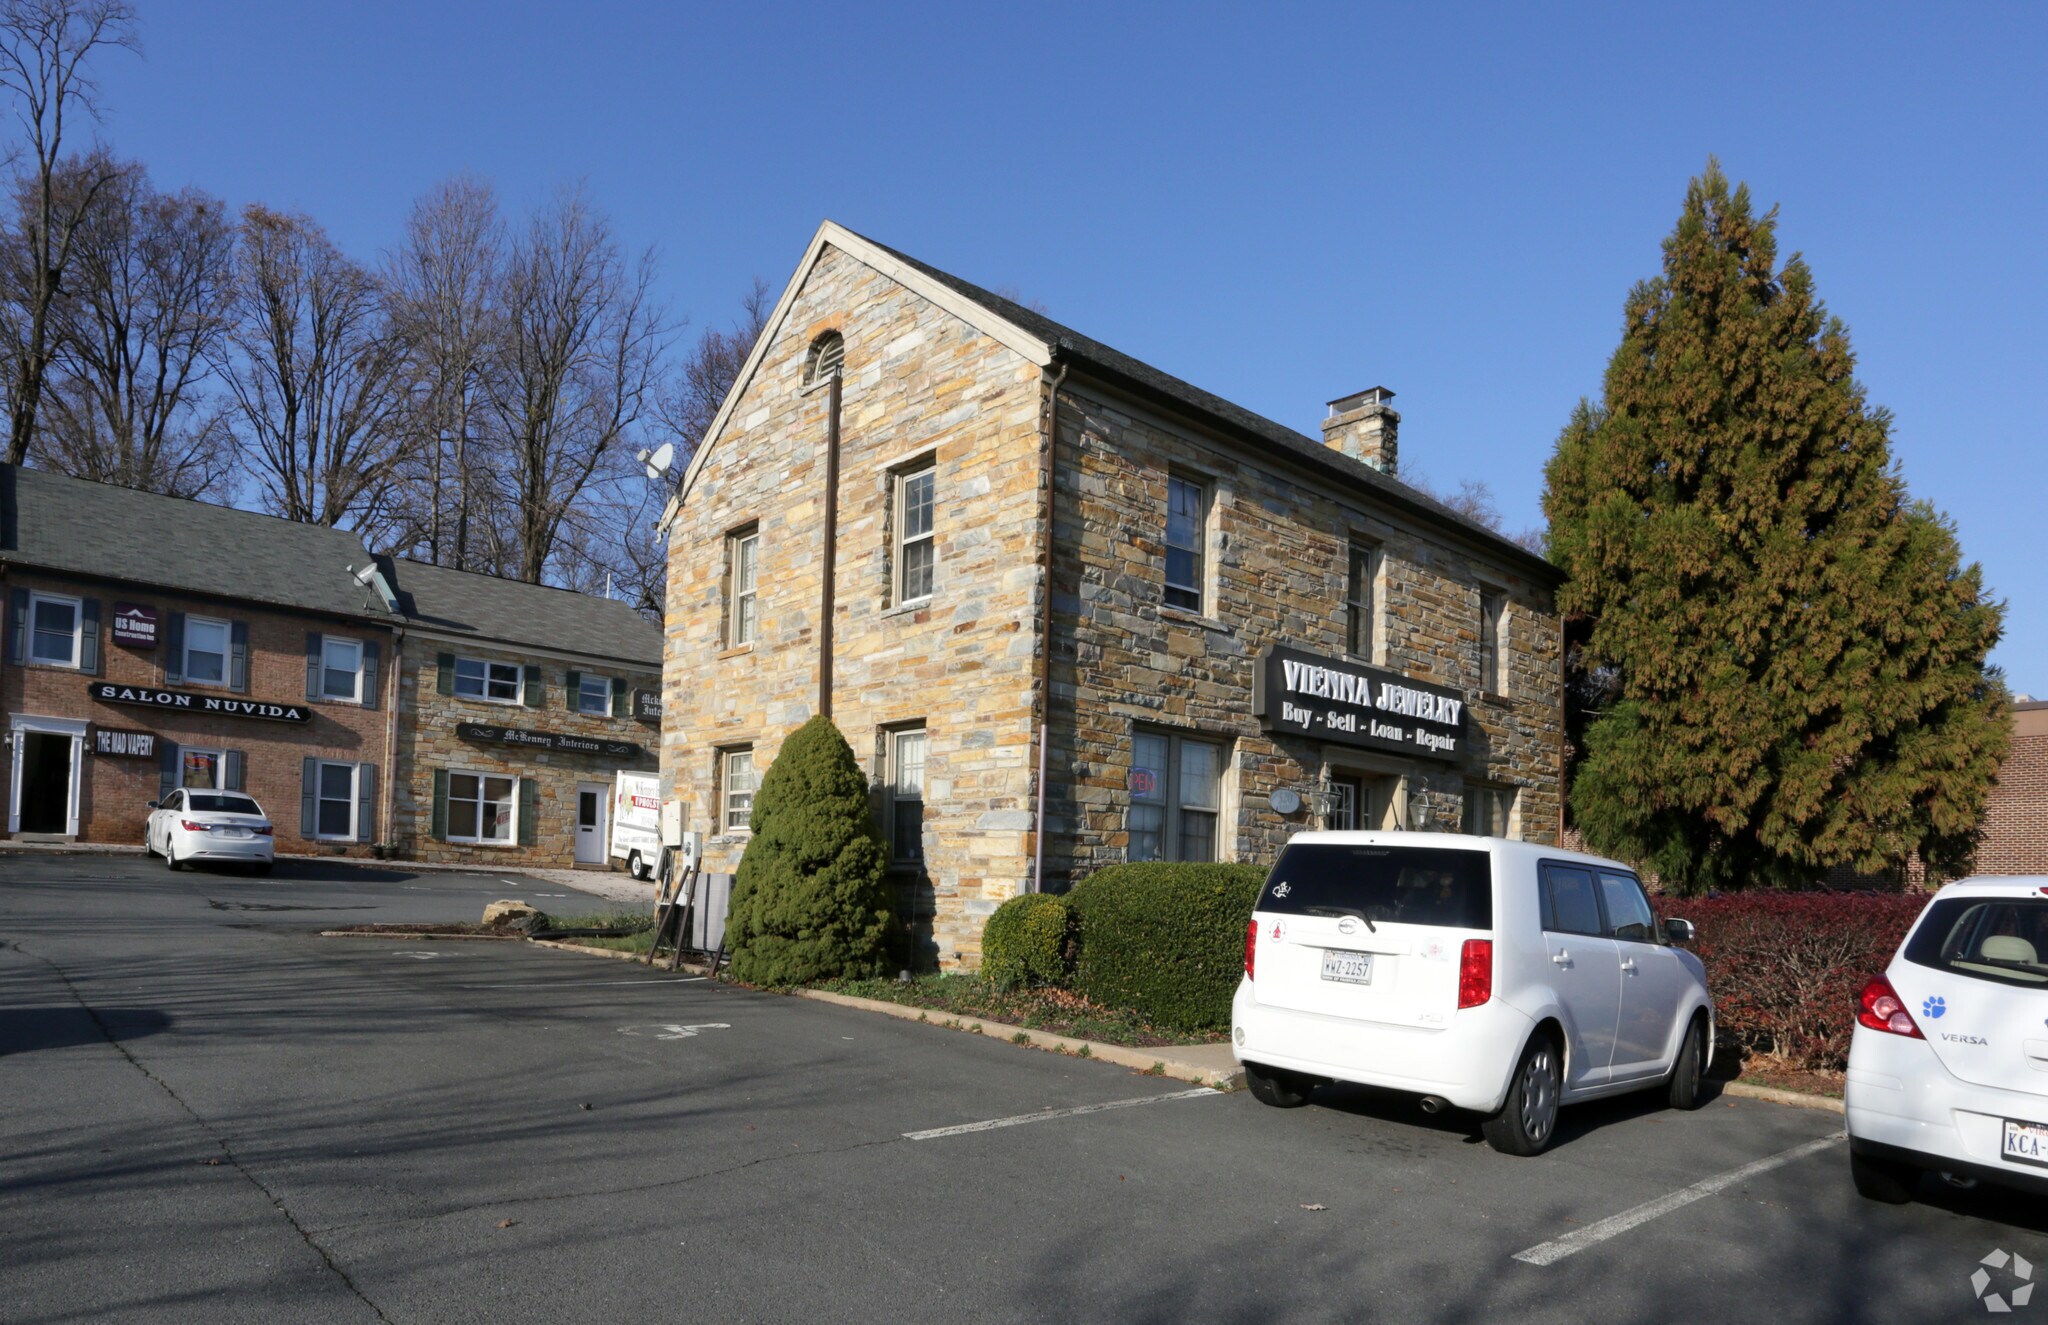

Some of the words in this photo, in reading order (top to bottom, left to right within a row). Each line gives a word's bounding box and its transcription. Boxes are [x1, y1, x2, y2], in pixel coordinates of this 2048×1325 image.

[115, 617, 128, 630] US
[129, 619, 155, 634] Home
[115, 629, 146, 640] Construction
[101, 686, 191, 706] SALON
[205, 699, 301, 719] NUVIDA
[1283, 659, 1372, 707] VIENNA
[1376, 682, 1463, 726] JEWELRY
[1283, 701, 1313, 730] Buy
[1327, 711, 1356, 733] Sell
[1370, 719, 1403, 741] Loan
[1416, 728, 1456, 752] Repair
[97, 731, 110, 752] THE
[111, 732, 126, 754] MAD
[127, 735, 154, 757] VAPERY
[503, 730, 552, 747] McKenney
[557, 737, 600, 751] Interiors
[1325, 959, 1369, 977] WWZ-2257
[1941, 1032, 1988, 1046] VERSA
[2008, 1132, 2048, 1156] KCA-
